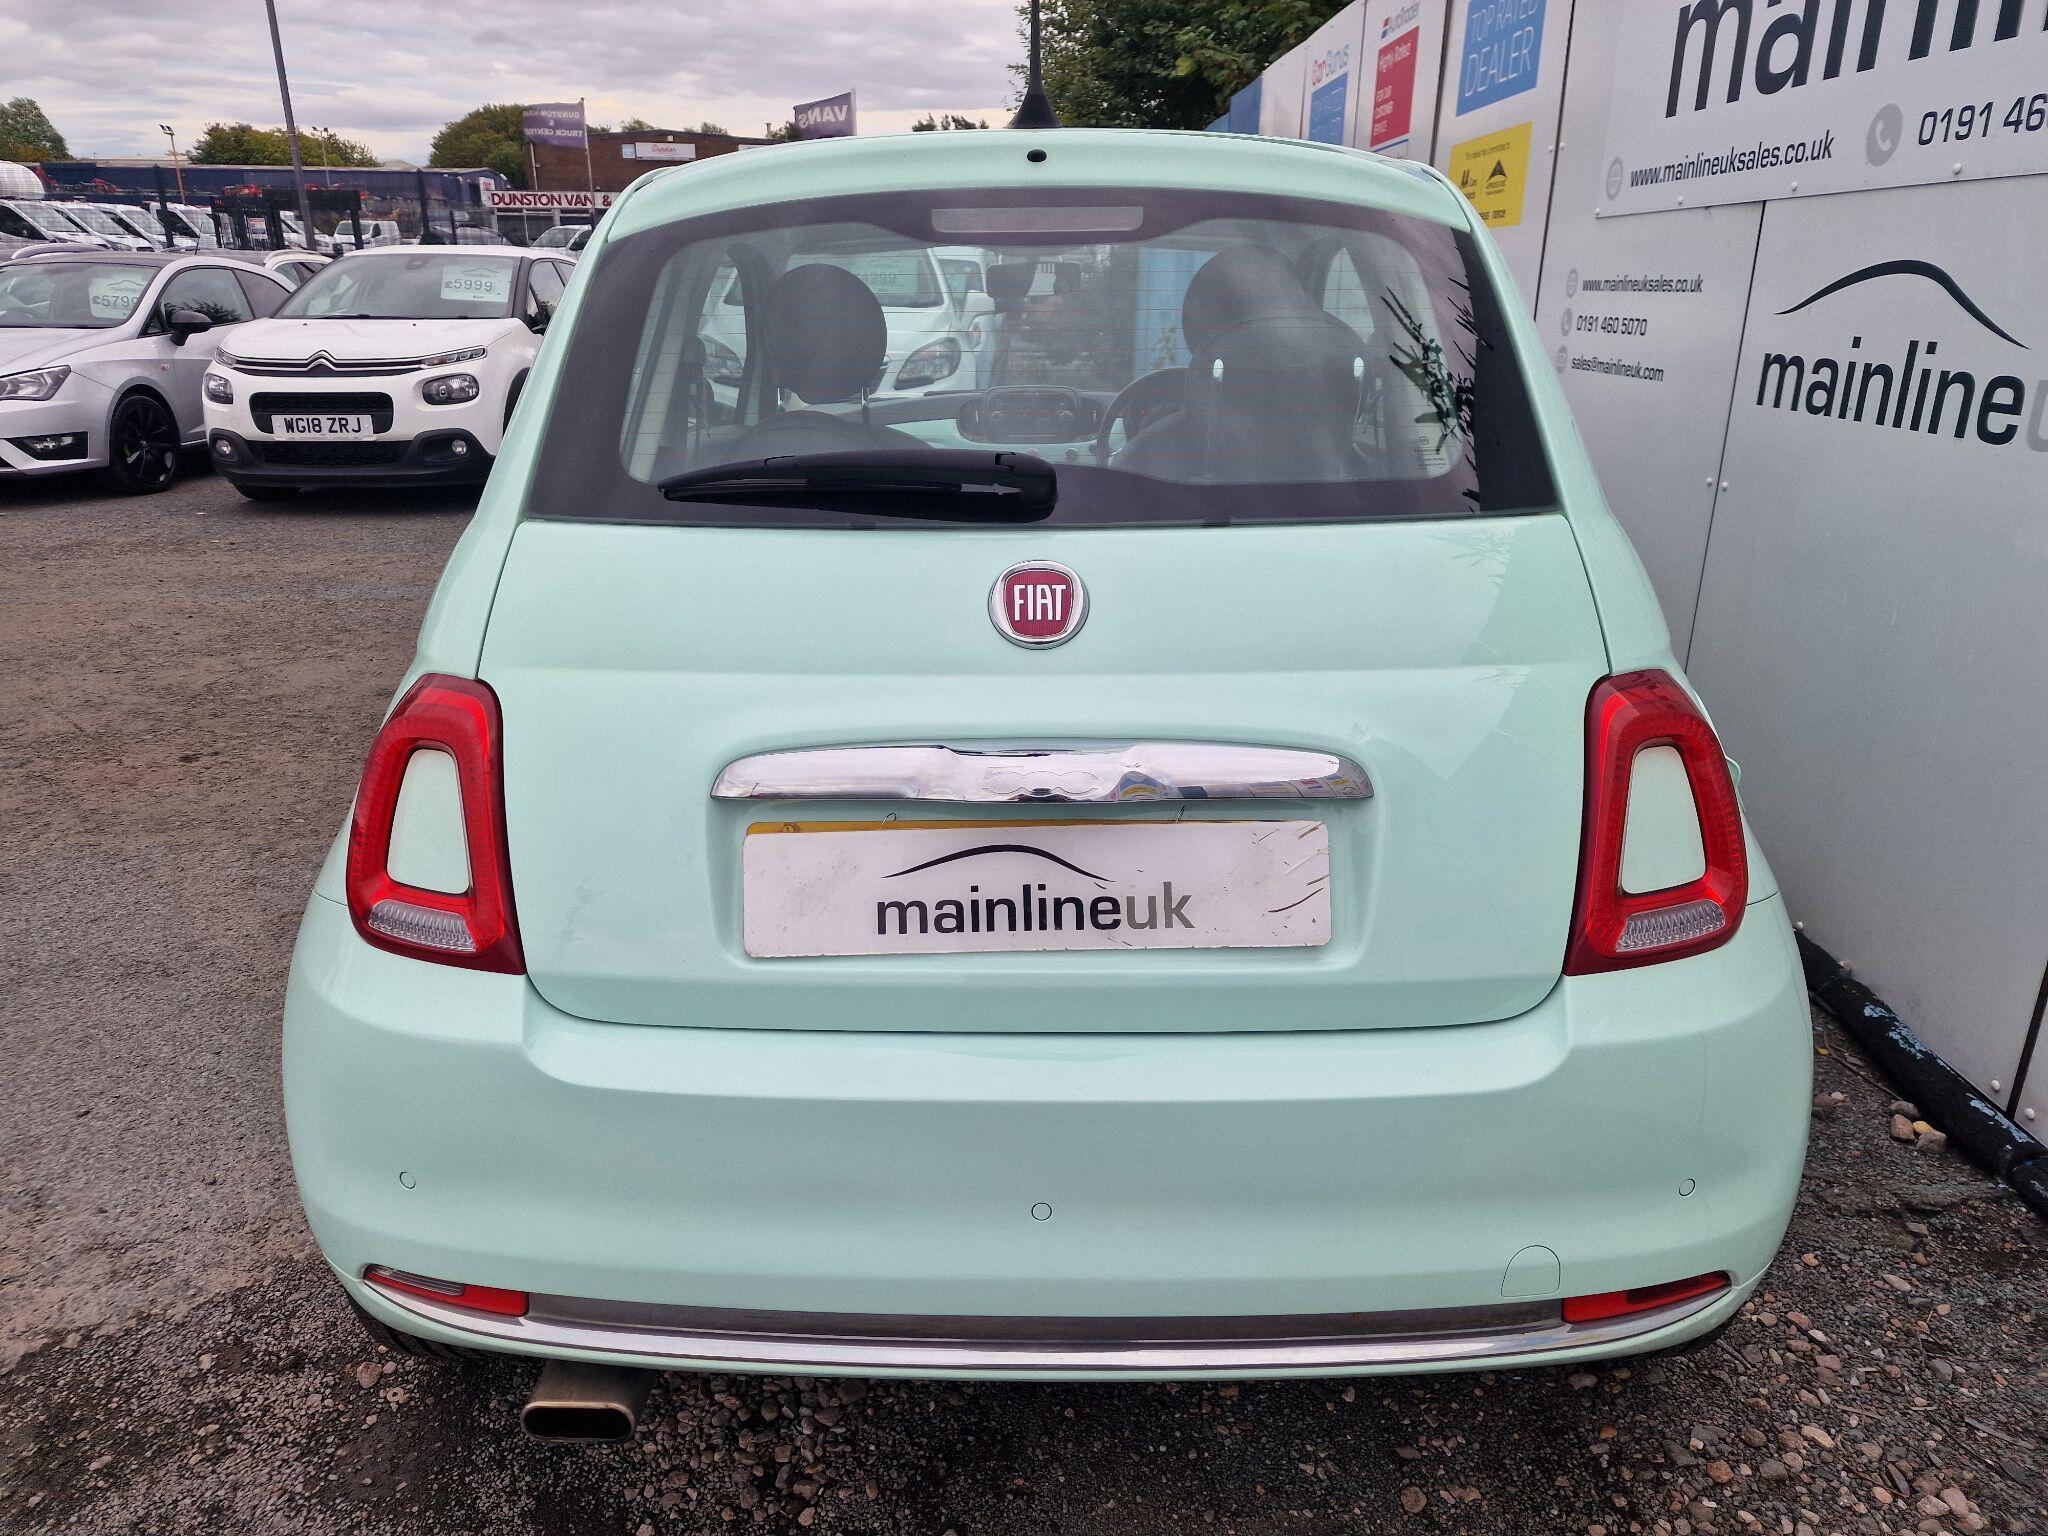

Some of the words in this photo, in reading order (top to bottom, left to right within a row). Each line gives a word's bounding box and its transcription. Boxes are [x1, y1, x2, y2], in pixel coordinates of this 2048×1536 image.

[1465, 26, 1534, 97] DEALER
[1918, 101, 1994, 146] 0191
[2003, 93, 2048, 134] 46
[1630, 129, 1836, 187] www.mainlineuksales.co.uk
[490, 192, 562, 206] DUNSTON
[564, 193, 594, 207] VAN
[602, 194, 612, 207] &
[1582, 273, 1704, 293] www.mainlineuksales.co.uk
[1576, 314, 1599, 333] 0191
[1601, 316, 1619, 334] 460
[1620, 317, 1648, 336] 5070
[1571, 354, 1665, 382] sales@mainlineuk.com
[283, 417, 322, 433] WG18
[326, 417, 362, 433] ZRJ
[1013, 584, 1067, 621] FIAT
[876, 881, 1197, 935] mainlineuk
